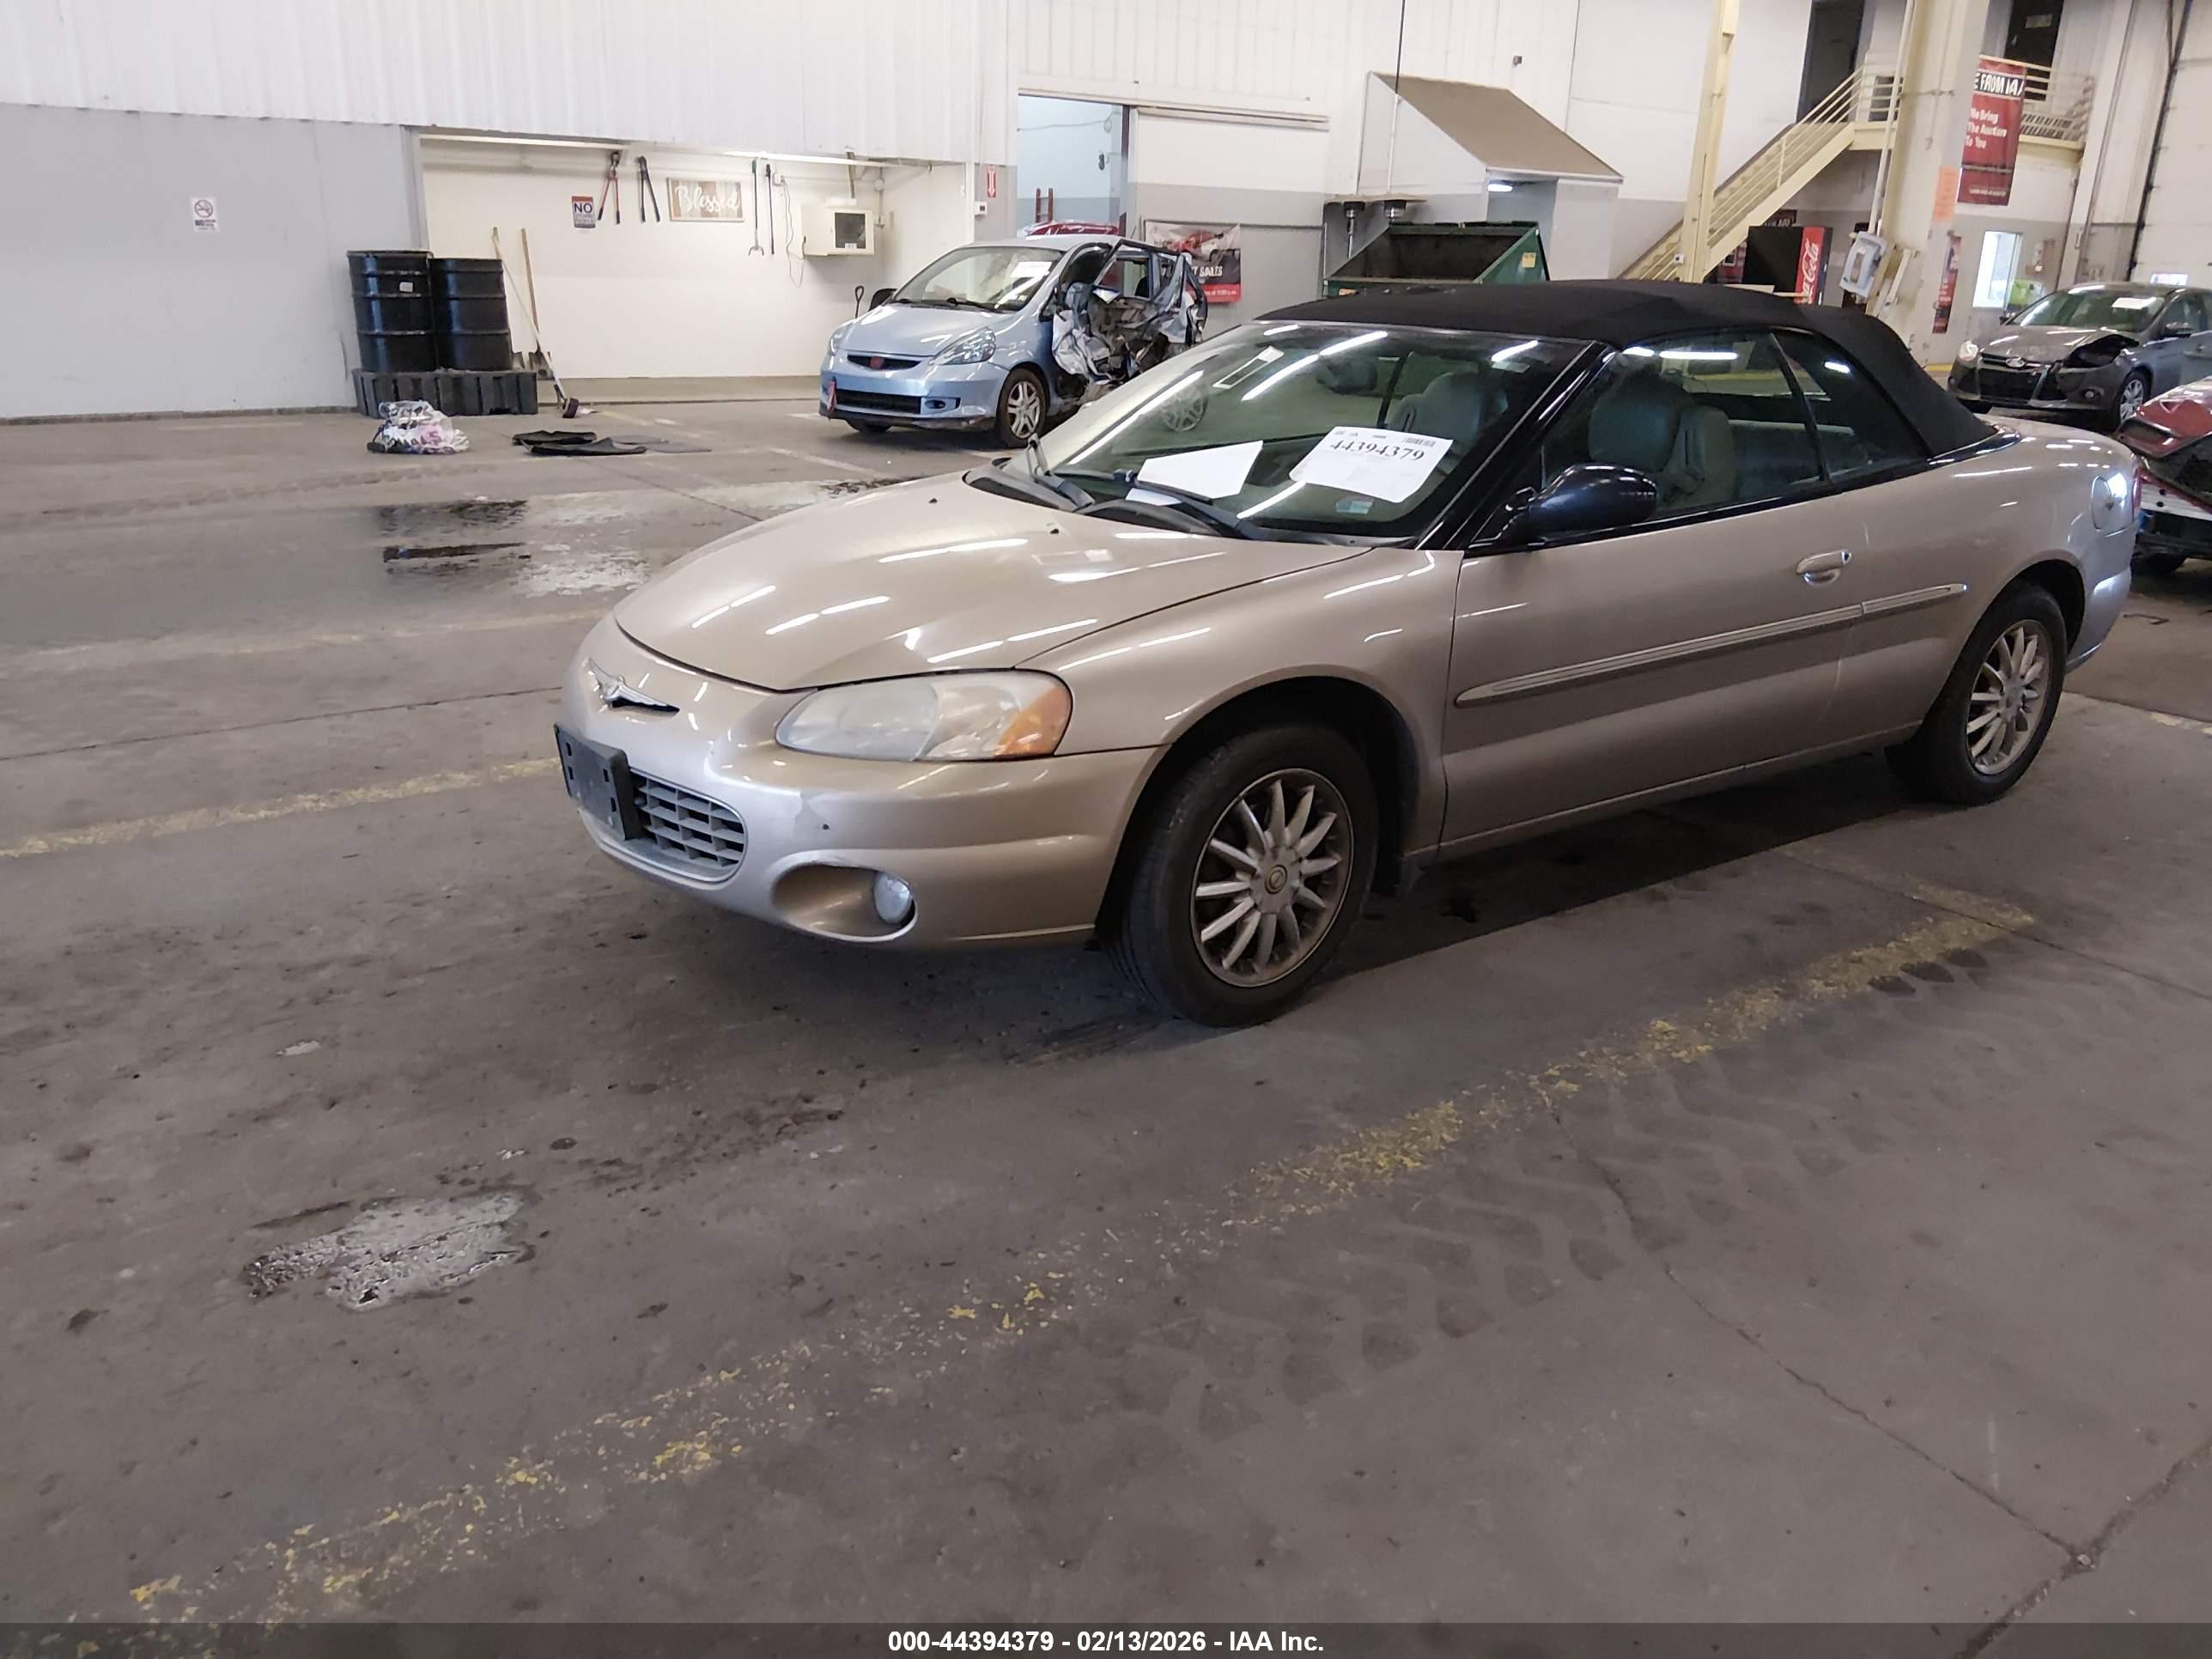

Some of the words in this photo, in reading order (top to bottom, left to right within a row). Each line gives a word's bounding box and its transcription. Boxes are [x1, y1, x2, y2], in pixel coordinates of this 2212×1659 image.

[1980, 73, 2005, 94] FROM
[1979, 110, 1998, 125] Bring
[1980, 124, 2007, 137] Auction
[1975, 137, 1987, 149] You
[675, 185, 740, 214] Blessed
[574, 203, 592, 214] NO
[1330, 440, 1425, 460] 44394379
